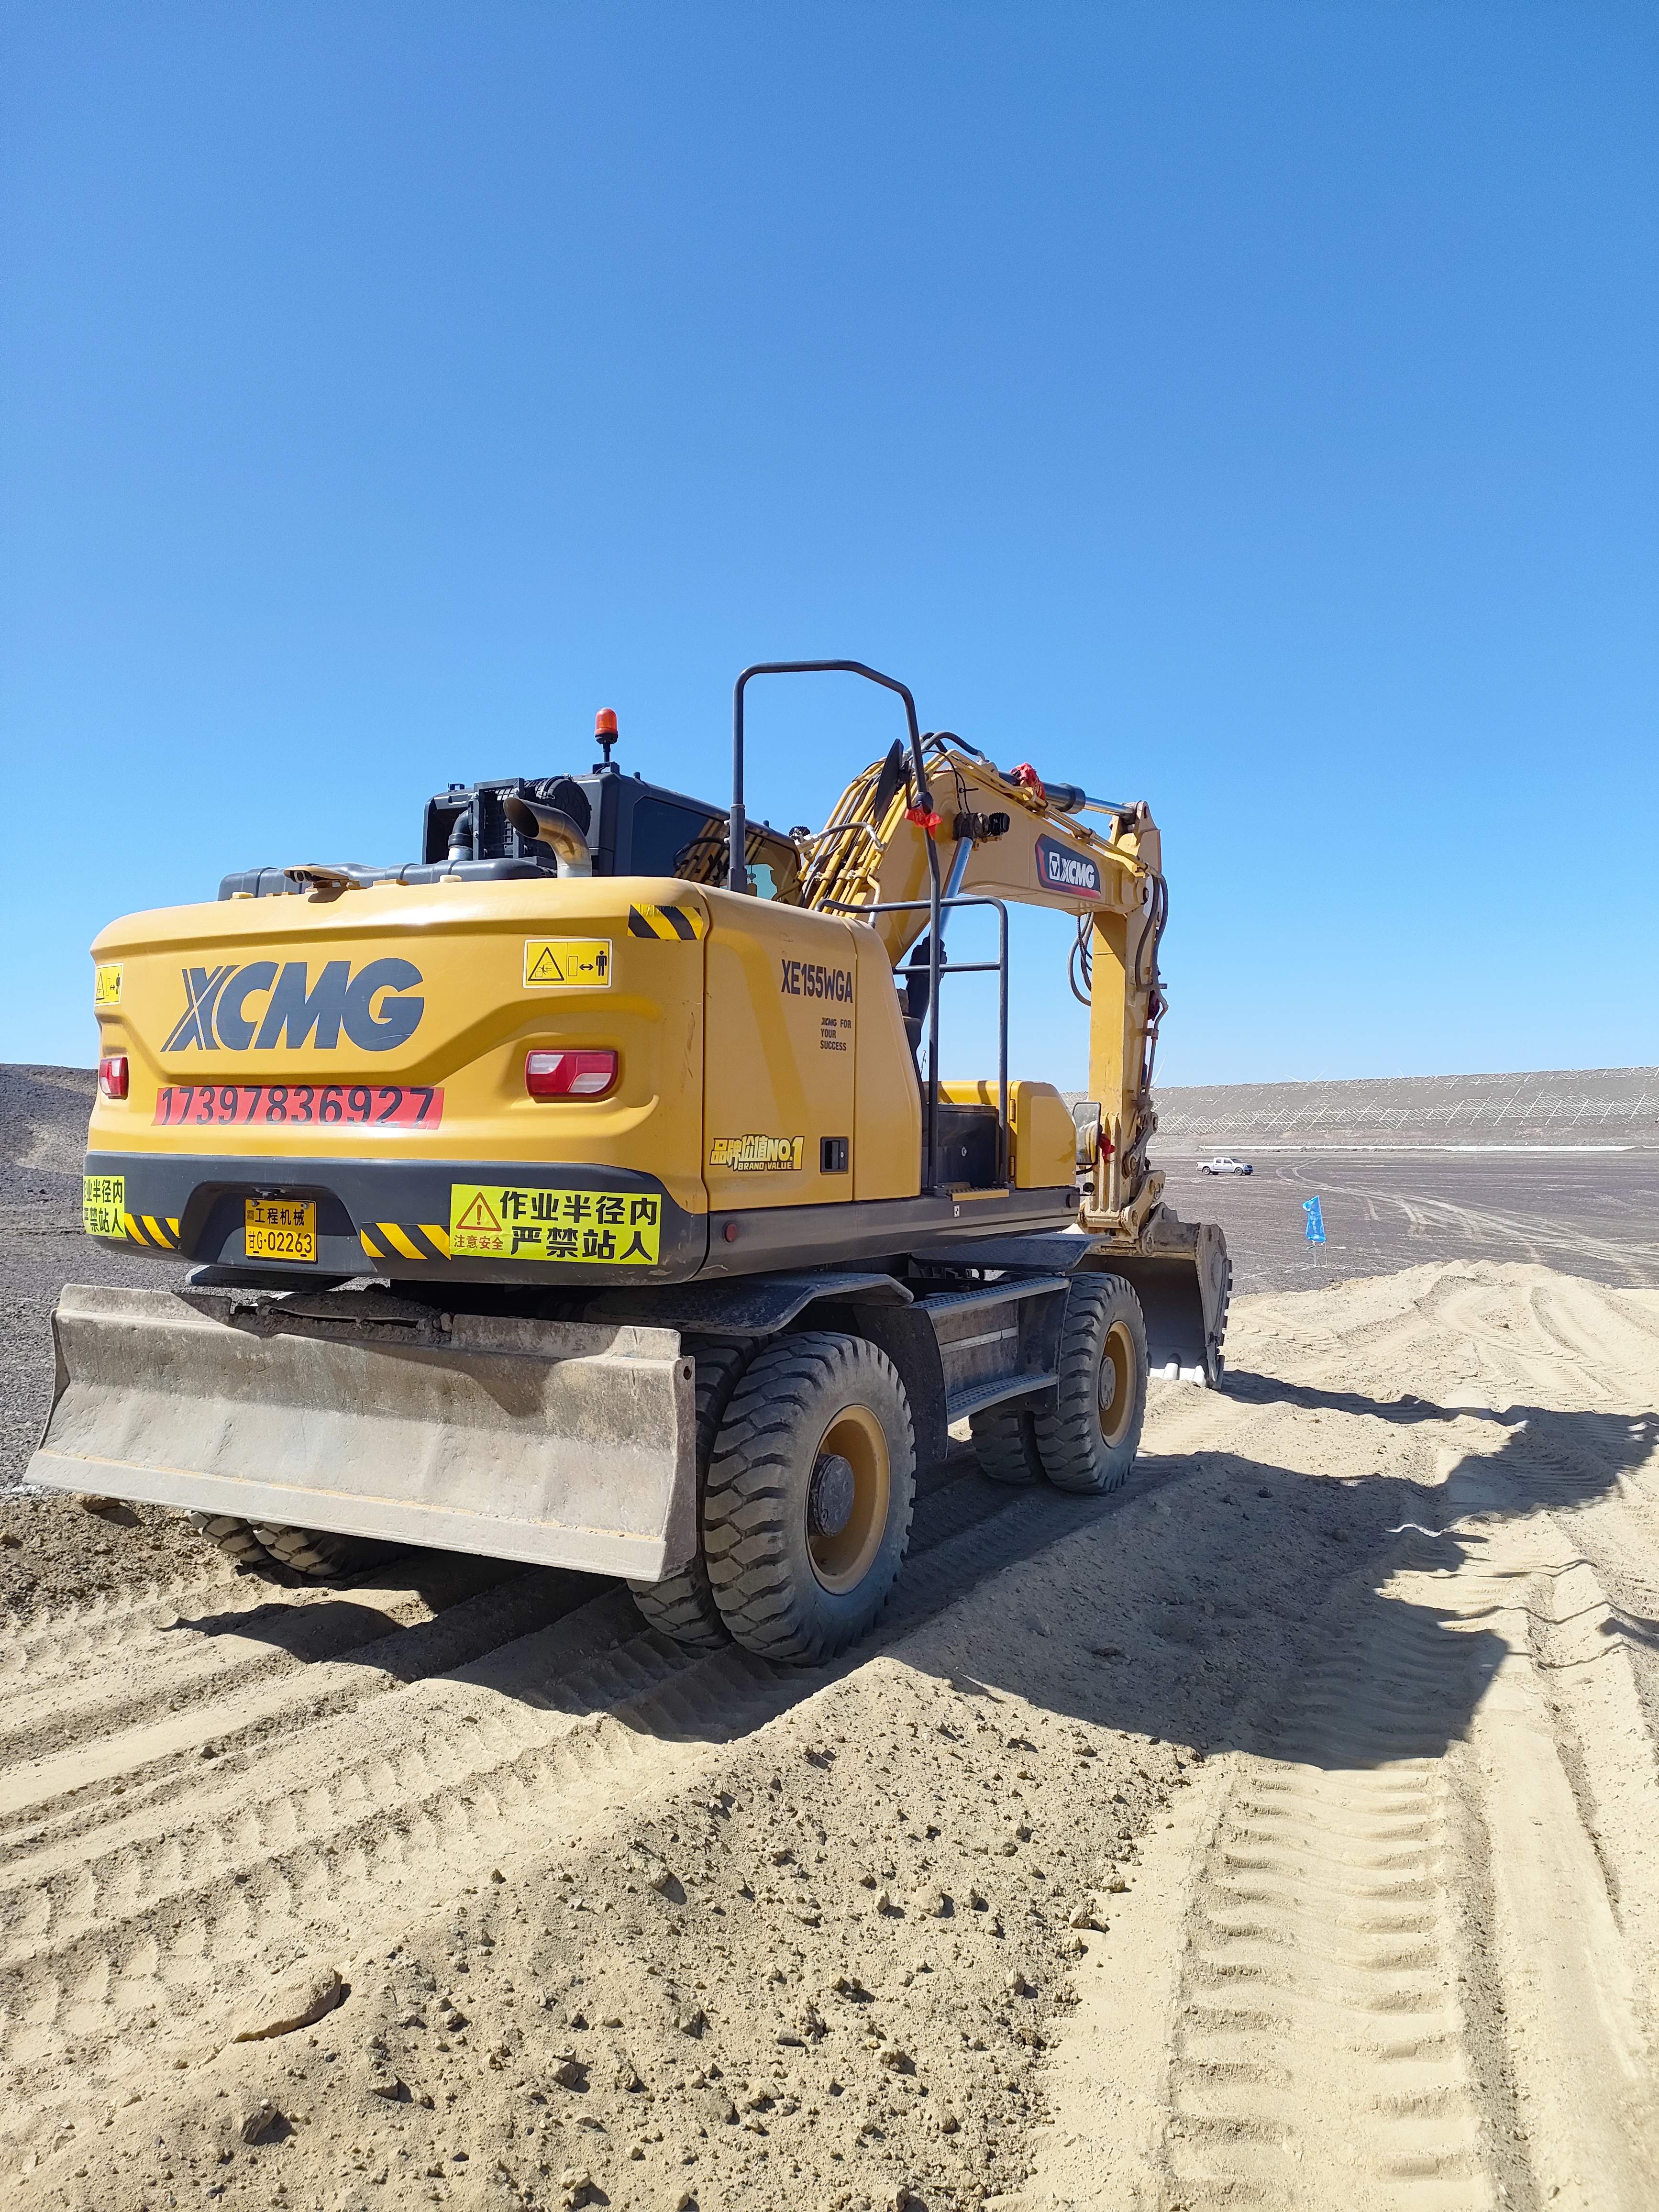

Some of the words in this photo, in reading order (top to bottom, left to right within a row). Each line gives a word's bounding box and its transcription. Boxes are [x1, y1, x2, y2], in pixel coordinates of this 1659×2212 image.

[1060, 858, 1095, 888] XCMG
[781, 959, 853, 1003] XE155WGA
[160, 957, 425, 1052] XCMG
[820, 1028, 836, 1039] YOUR
[821, 1017, 837, 1027] XCMG
[840, 1019, 852, 1029] FOR
[820, 1040, 847, 1051] SUCCESS
[161, 1084, 434, 1128] 17397836927
[738, 1162, 765, 1170] BRAND
[767, 1161, 792, 1170] VALUE
[84, 1179, 123, 1204] 业半径内
[254, 1207, 305, 1226] 工程机械
[499, 1191, 658, 1226] 作业半径内
[453, 1234, 504, 1250] 注意安全
[510, 1226, 653, 1261] 严禁站人
